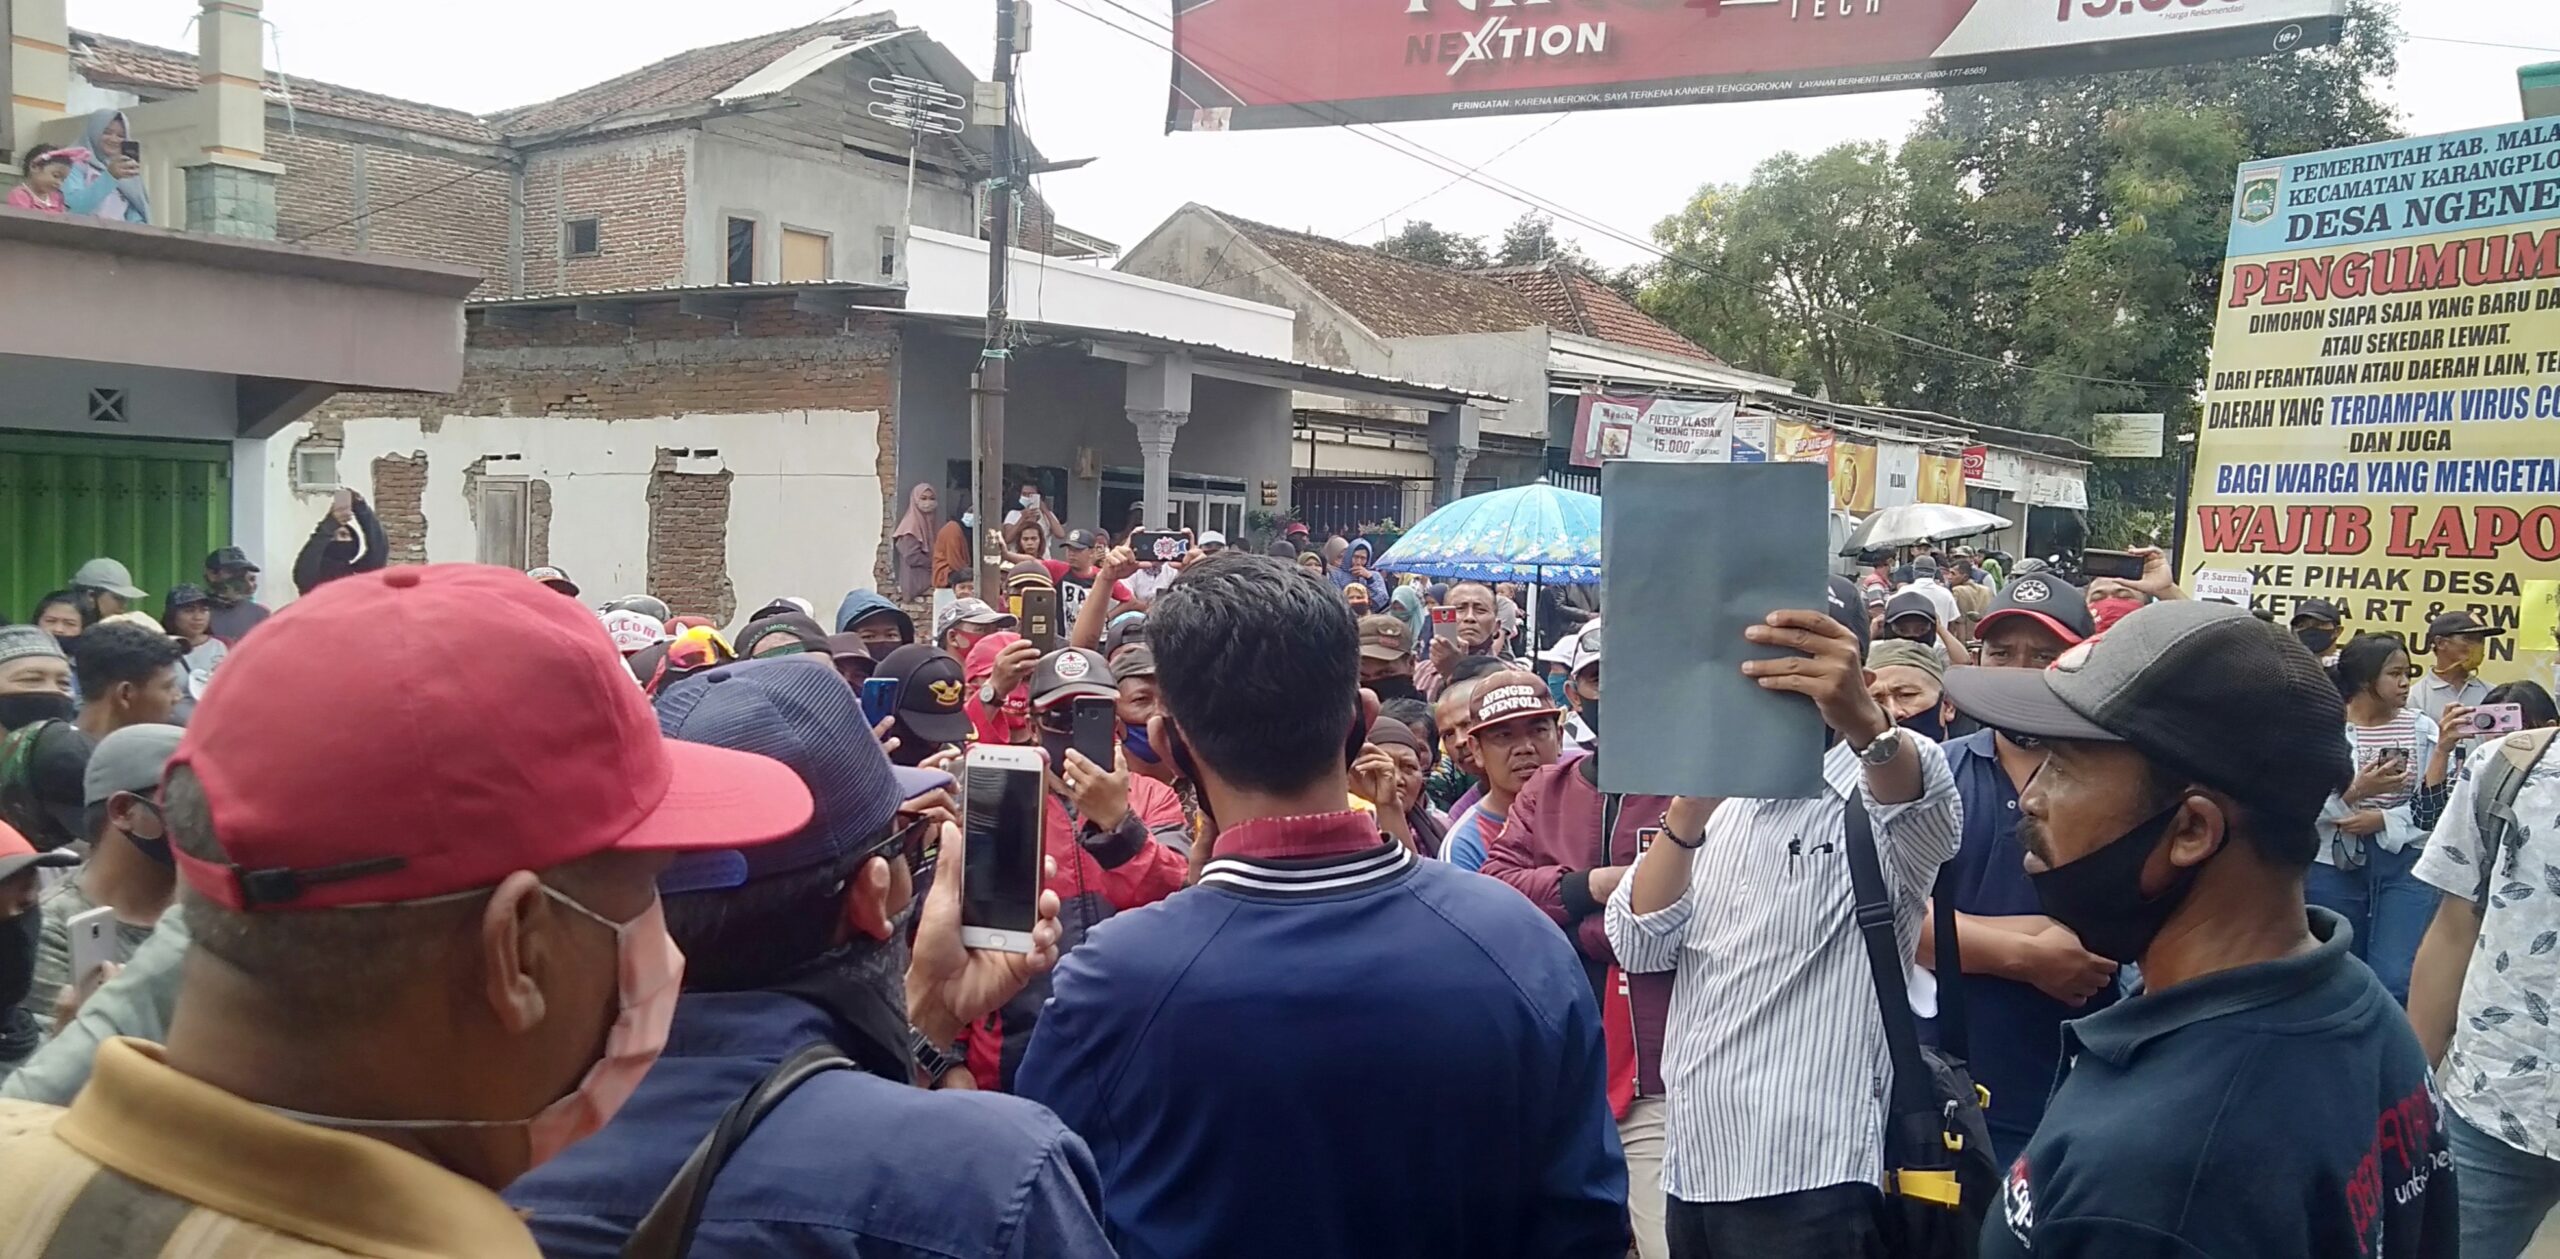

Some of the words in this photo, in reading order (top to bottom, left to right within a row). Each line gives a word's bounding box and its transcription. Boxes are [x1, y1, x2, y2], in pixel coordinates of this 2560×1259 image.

[1404, 16, 1606, 76] NEXTION
[2278, 32, 2297, 43] 18+
[1514, 98, 1552, 107] KARENA
[1604, 92, 1628, 102] SAYA
[1630, 89, 1674, 100] TERKENA
[1674, 86, 1714, 96] KANKER
[1717, 81, 1793, 94] TENGGOROKAN
[1799, 79, 1836, 88] LAYANAN
[1837, 76, 1880, 86] BERHENTI
[1880, 72, 1923, 82] MEROKOK
[2291, 150, 2431, 183] PEMERINTAH
[2437, 137, 2488, 161] KAB.
[2287, 172, 2416, 207] KECAMATAN
[2420, 150, 2560, 188] KARANGPLO
[2285, 203, 2392, 242] DESA
[2402, 178, 2560, 228] NGENE
[2228, 229, 2560, 308] PENGUMUM
[2249, 308, 2325, 334] DIMOHON
[2328, 304, 2377, 328] SIAPA
[2380, 300, 2422, 324] SAJA
[2428, 296, 2474, 320] YANG
[2478, 291, 2530, 316] BARU
[2320, 336, 2363, 357] ATAU
[2366, 329, 2444, 354] SEKEDAR
[2448, 323, 2510, 346] LEWAT.
[2214, 370, 2251, 391] DARI
[2254, 364, 2357, 390] PERANTAUAN
[2360, 361, 2403, 383] ATAU
[2407, 356, 2479, 380] DAERAH
[2483, 353, 2530, 376] LAIN,
[2536, 350, 2560, 373] TE
[1649, 414, 1680, 426] FILTER
[1681, 416, 1717, 428] KLASIK
[2208, 400, 2274, 429] DAERAH
[2279, 397, 2325, 427] YANG
[2330, 391, 2455, 426] TERDAMPAK
[2460, 387, 2529, 421] VIRUS
[1654, 426, 1688, 437] MEMANG
[1690, 428, 1722, 438] TERBAIK
[2349, 431, 2393, 453] DAN
[2396, 429, 2452, 452] JUGA
[2217, 464, 2270, 494] BAGI
[2274, 463, 2359, 493] WARGA
[2366, 461, 2428, 493] YANG
[2434, 459, 2560, 493] MENGETA
[2197, 505, 2373, 555] WAJIB
[2386, 505, 2560, 561] LAPO
[2252, 564, 2293, 587] KE
[2304, 566, 2412, 591] PIHAK
[2423, 569, 2521, 597] DESA
[2249, 594, 2352, 620] KETA
[2365, 598, 2412, 623] RT
[2466, 603, 2521, 630] RW
[1478, 696, 1542, 721] SEVENFOLD
[1482, 685, 1534, 707] AVENGED
